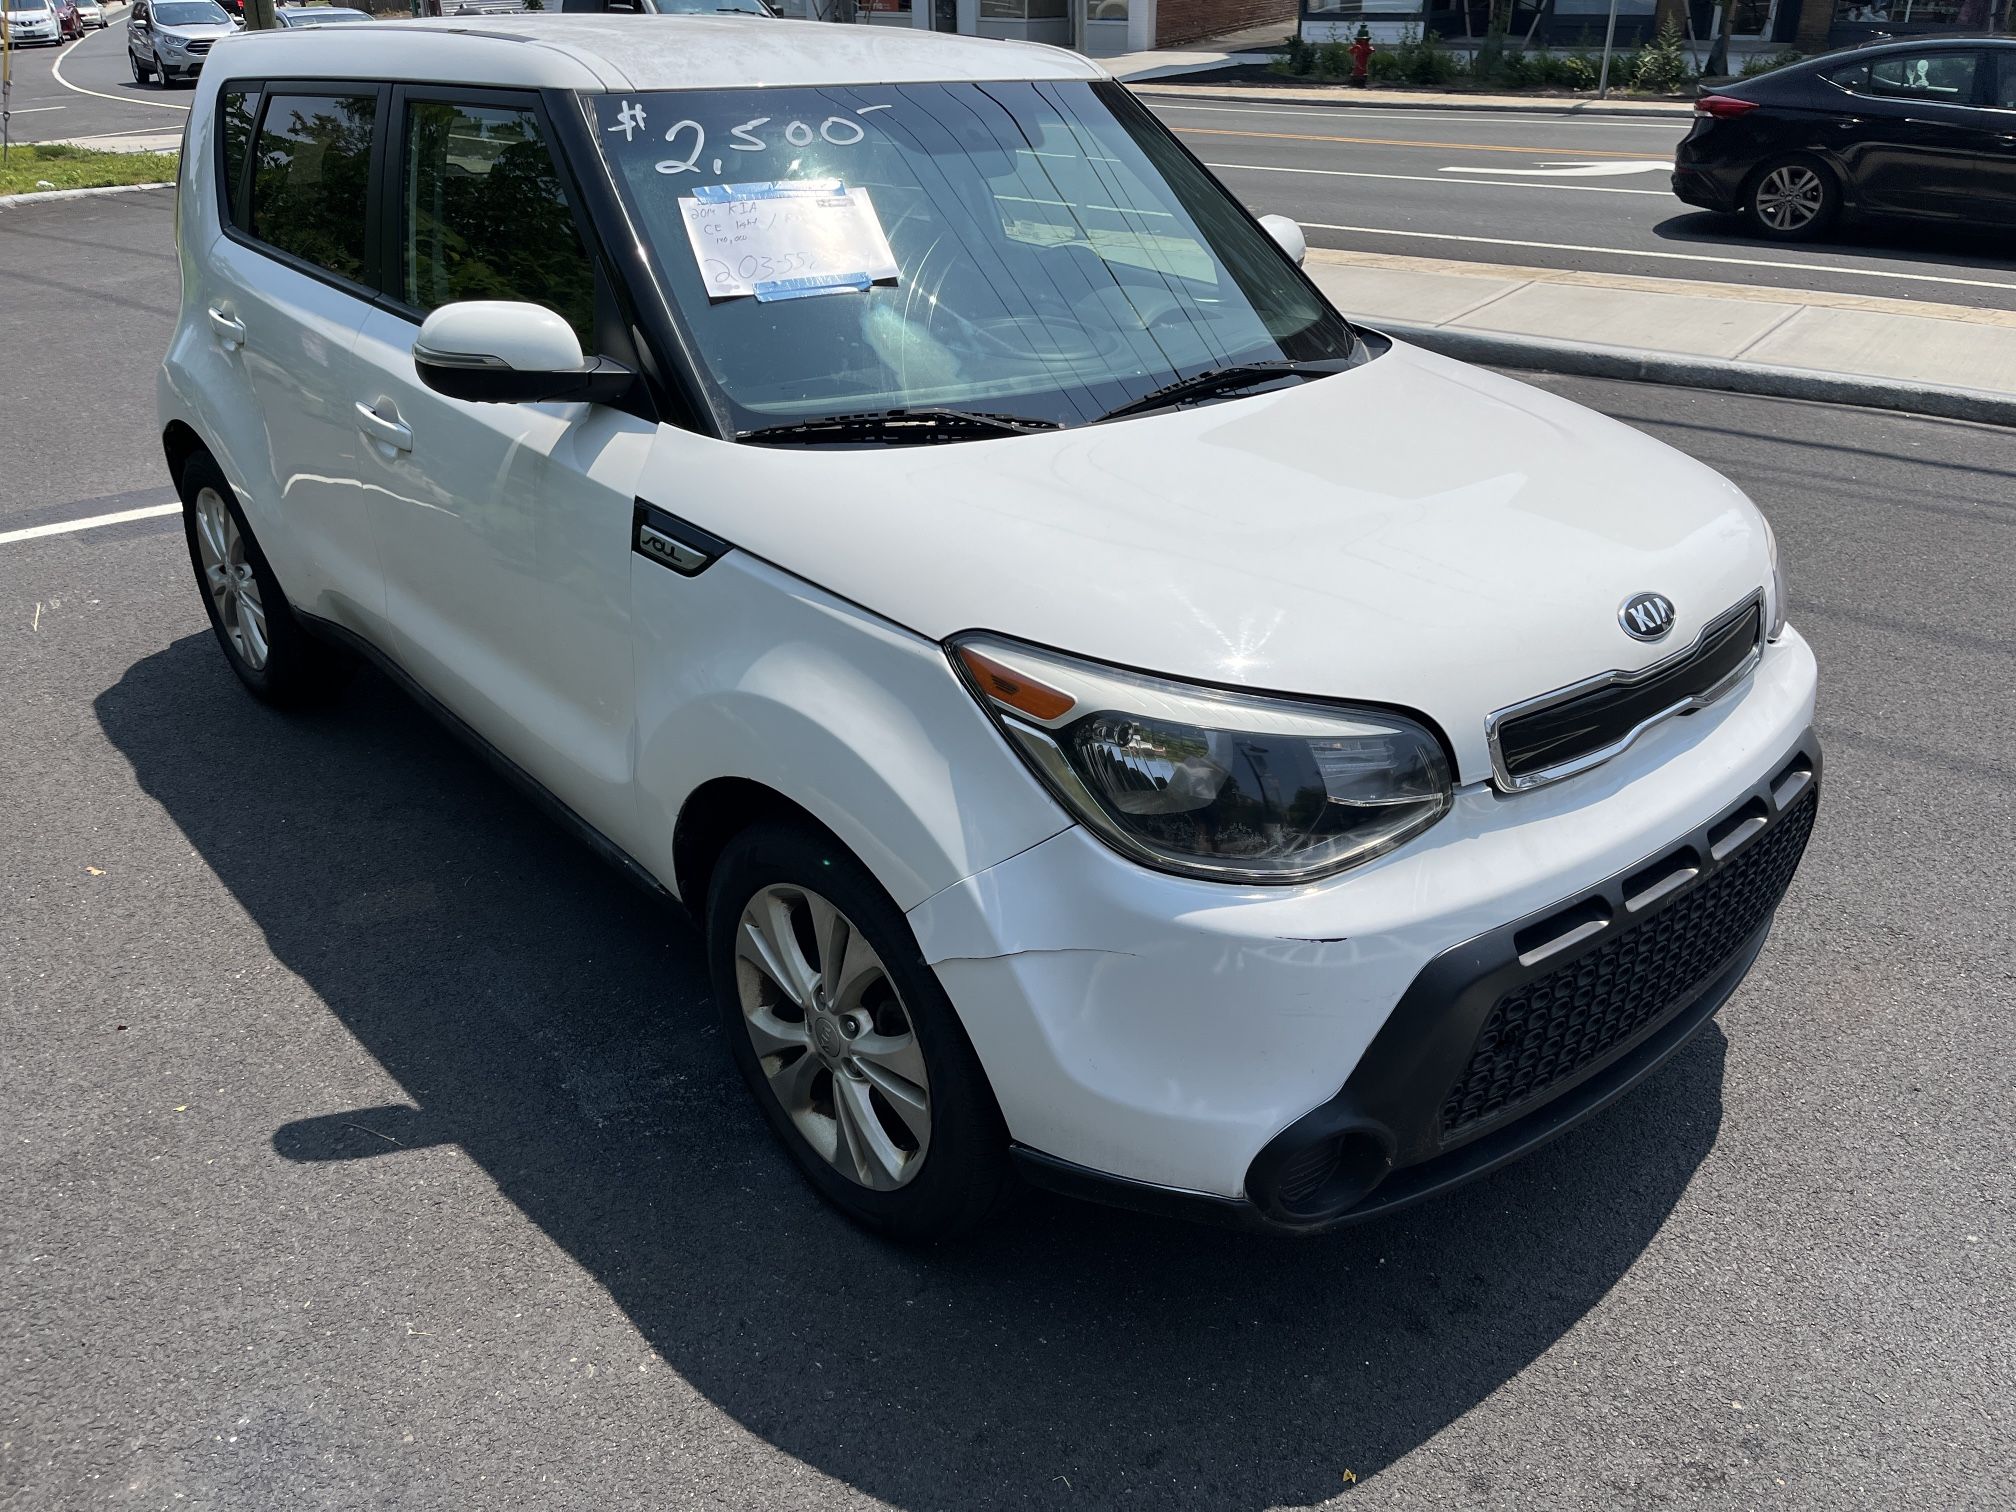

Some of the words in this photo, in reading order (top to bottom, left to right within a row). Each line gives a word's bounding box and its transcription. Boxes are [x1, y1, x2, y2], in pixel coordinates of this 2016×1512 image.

[728, 201, 758, 216] KIA
[641, 535, 683, 563] SOUL
[1627, 597, 1675, 632] KIA
